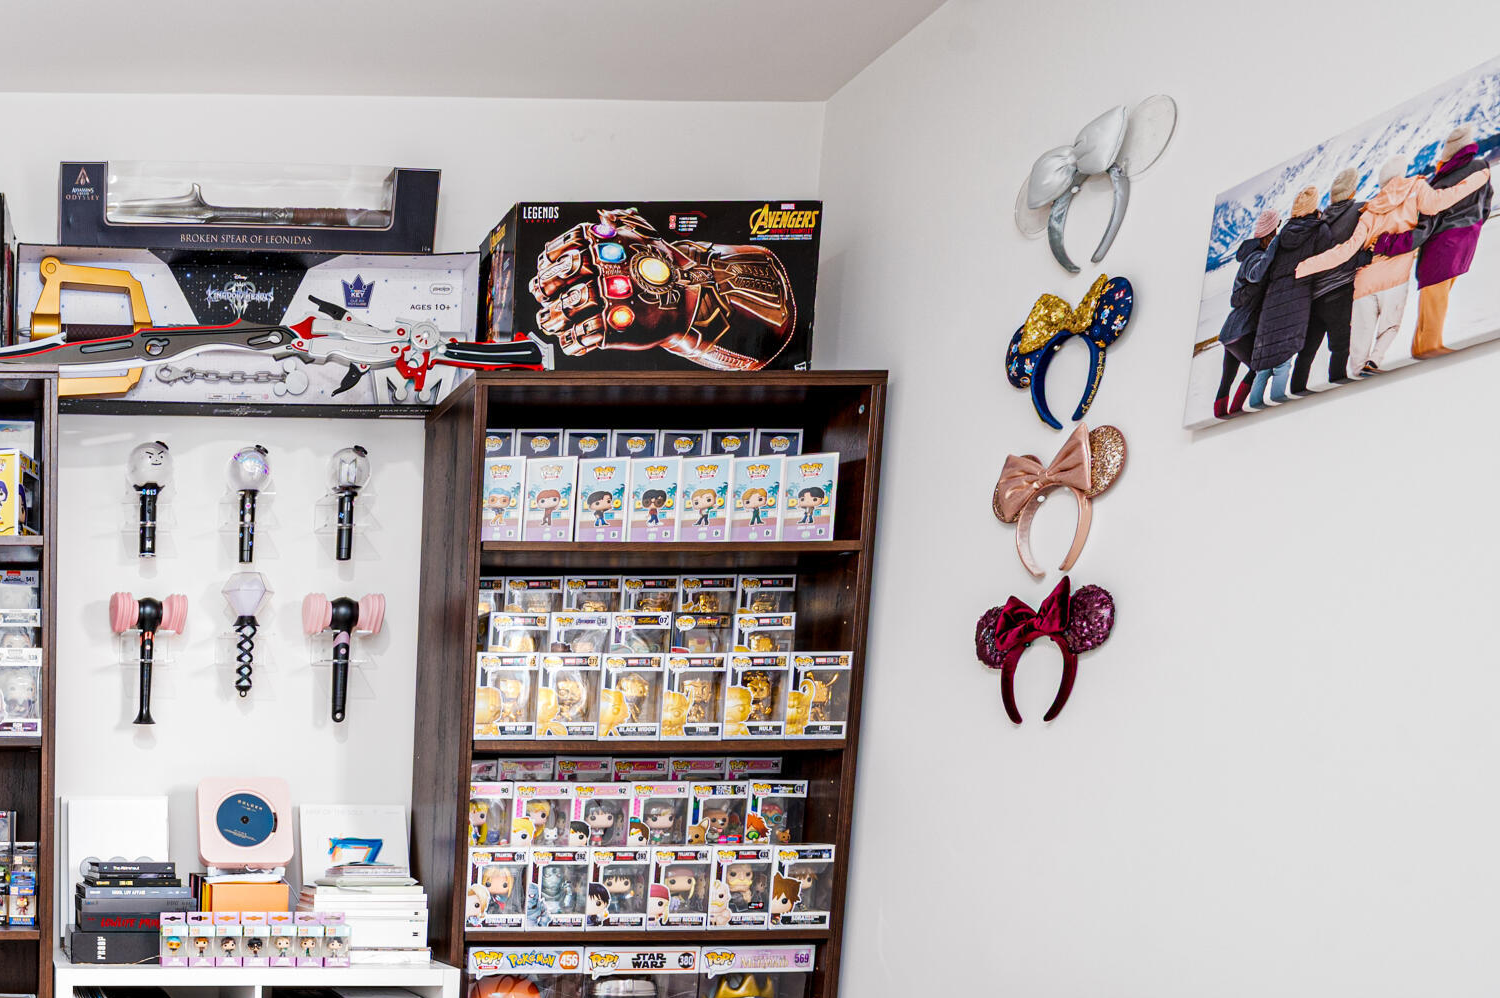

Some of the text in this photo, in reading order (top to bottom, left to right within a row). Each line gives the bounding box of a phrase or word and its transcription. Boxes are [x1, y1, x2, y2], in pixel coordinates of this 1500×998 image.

[523, 206, 559, 218] LEGENDS
[750, 204, 820, 234] AVENGERS
[180, 234, 312, 244] BROKEN SPEAR OF LEONIDAS
[638, 852, 646, 860] 393
[97, 936, 106, 960] PROOF
[474, 951, 503, 966] POP!
[560, 954, 578, 966] 456
[589, 954, 618, 968] POP!
[632, 960, 666, 968] WARS
[678, 956, 694, 965] 380
[704, 952, 736, 966] POP!
[794, 953, 809, 964] 569
